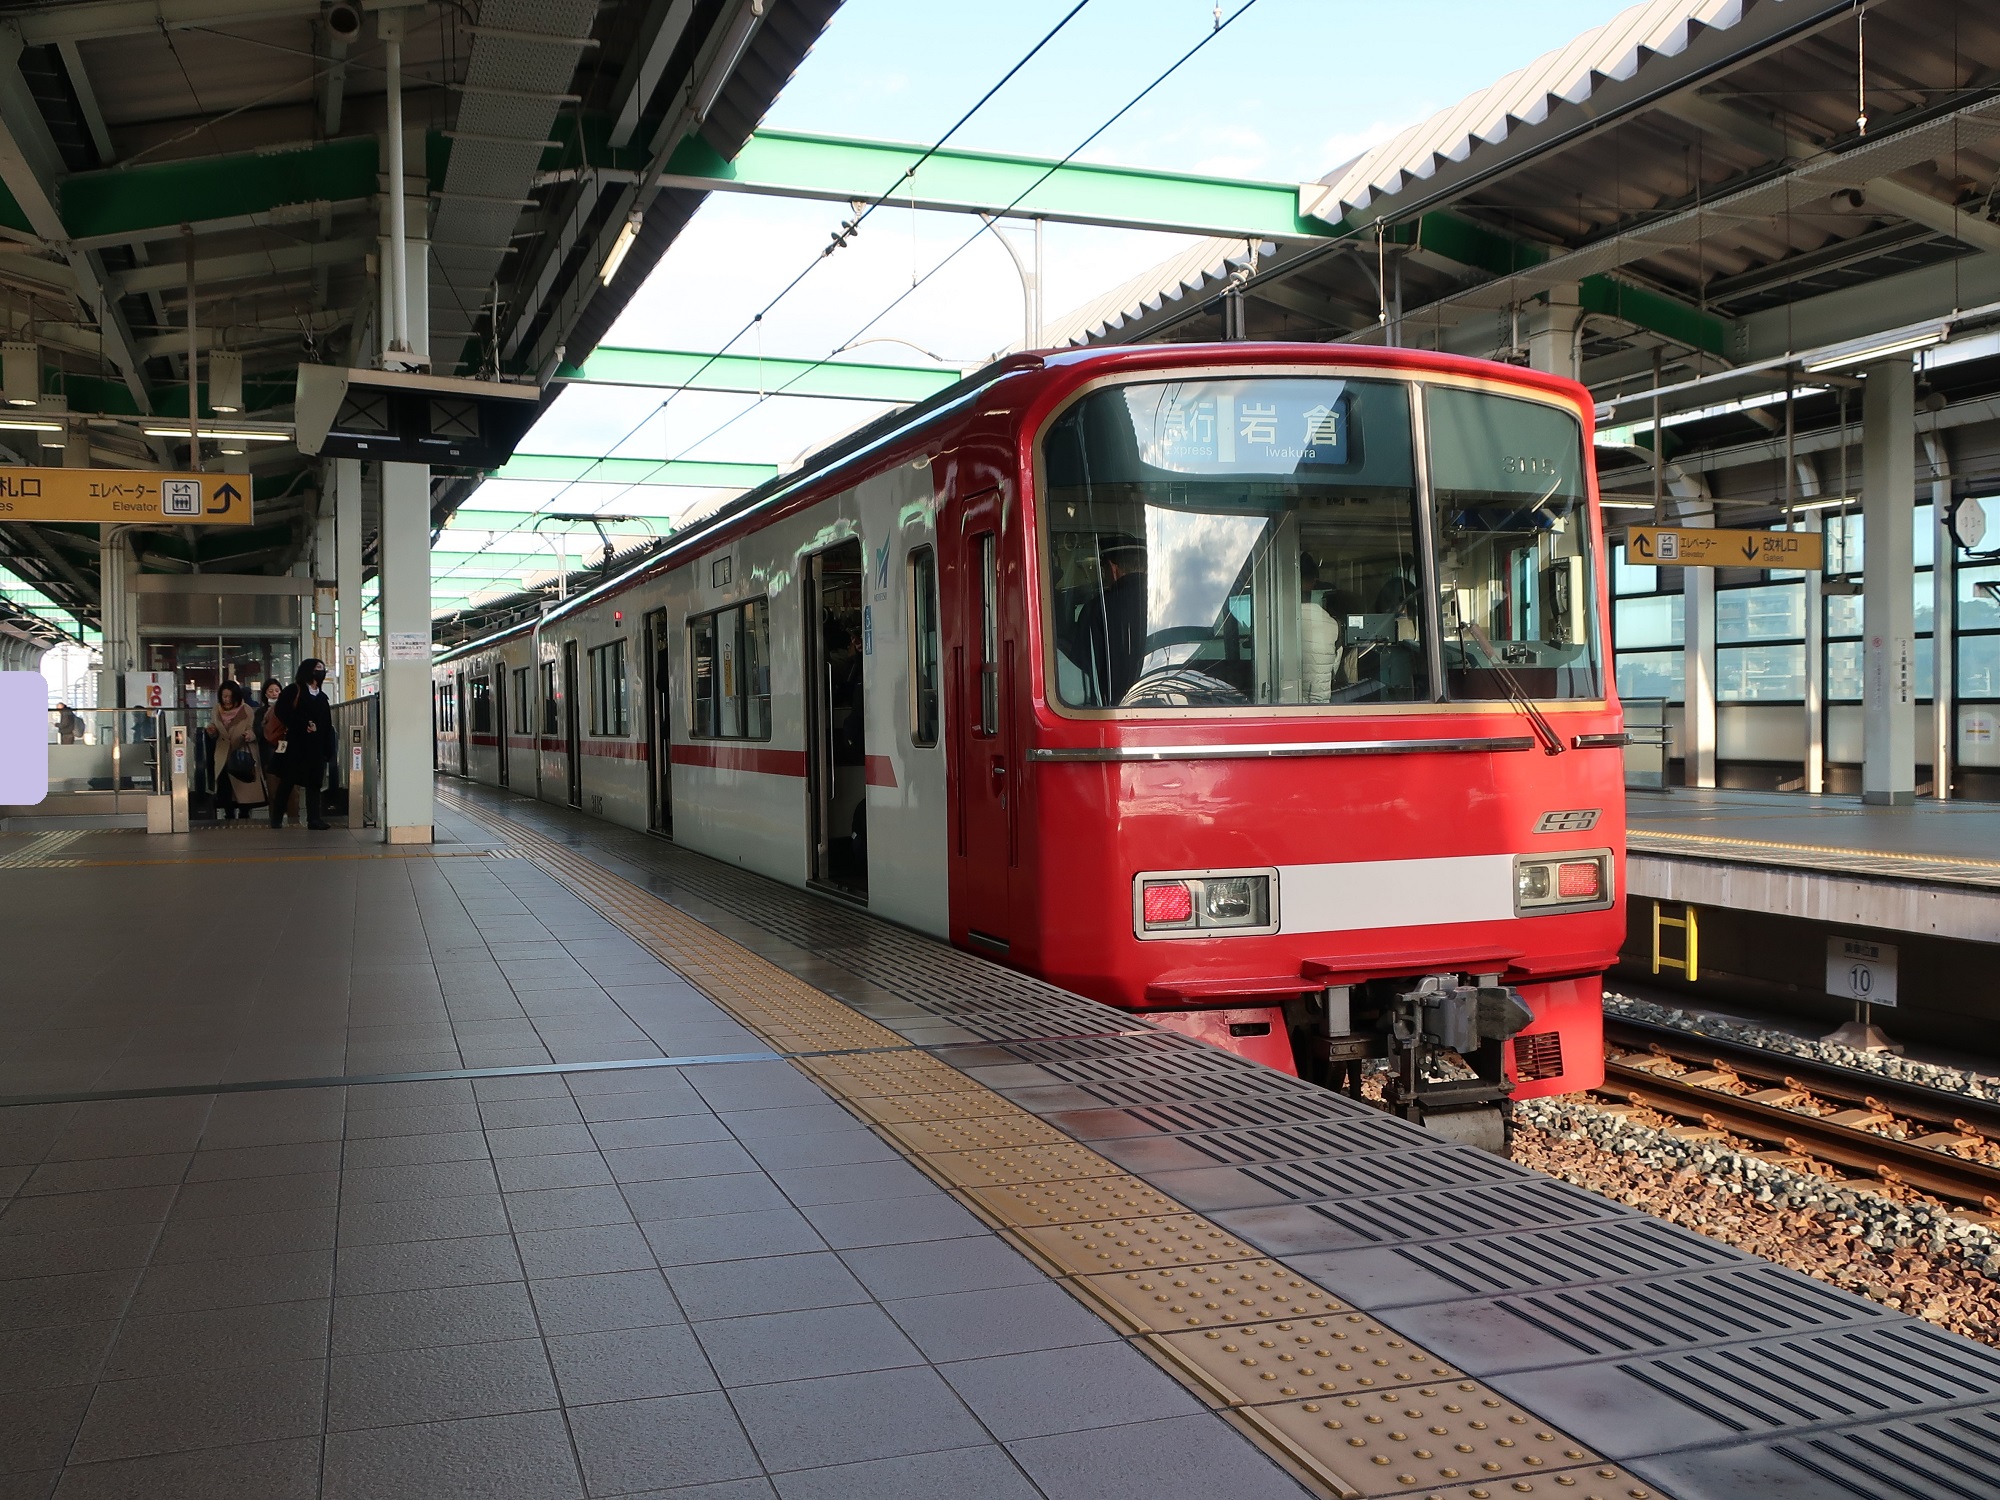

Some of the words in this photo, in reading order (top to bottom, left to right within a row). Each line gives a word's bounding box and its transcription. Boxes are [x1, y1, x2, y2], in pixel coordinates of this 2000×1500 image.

[1240, 402, 1340, 446] 岩倉
[1265, 446, 1316, 458] Iwakura
[1502, 456, 1556, 476] 3115
[89, 483, 157, 499] エレベーター
[112, 501, 158, 512] Elevator
[1680, 537, 1718, 549] エレベーター
[1763, 537, 1798, 552] 改札口
[1680, 550, 1705, 558] Elevator
[1763, 553, 1784, 562] Gates
[1851, 968, 1871, 992] 10
